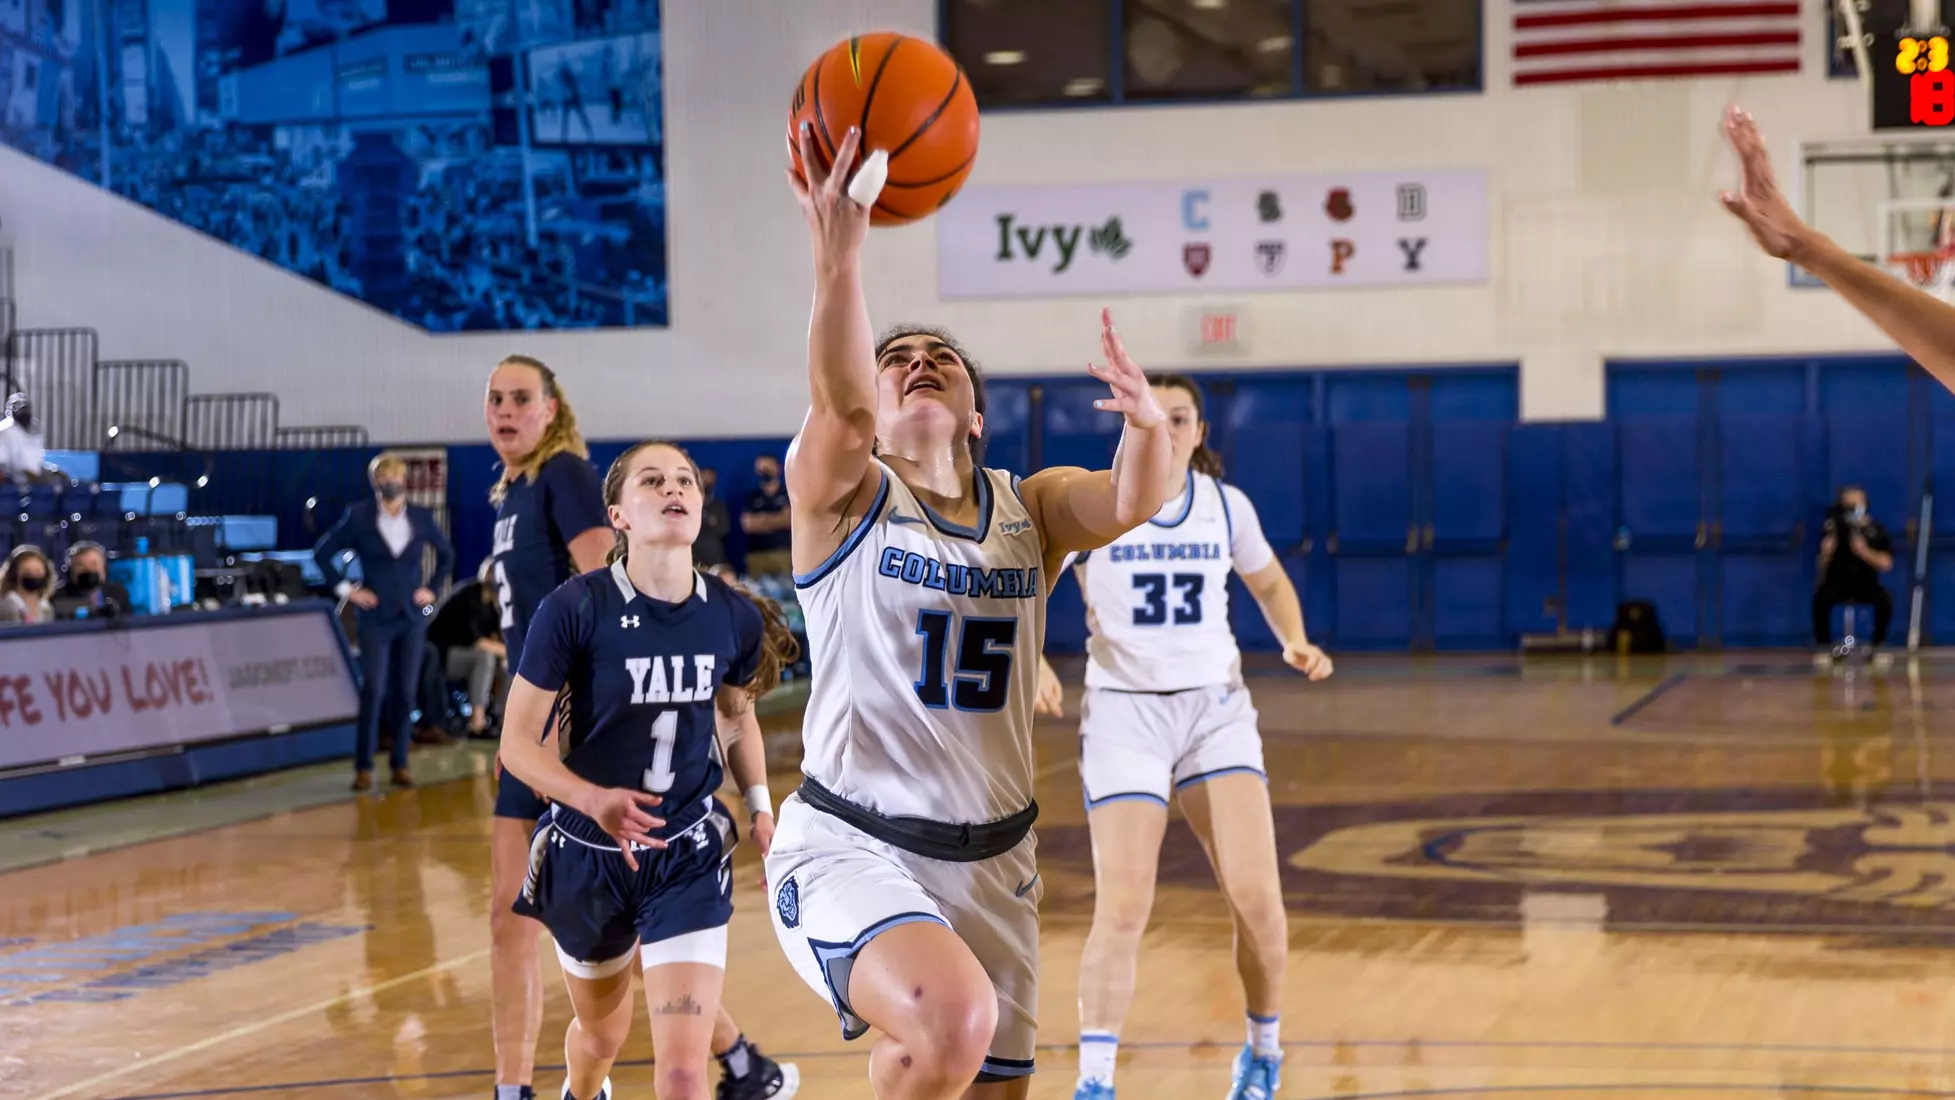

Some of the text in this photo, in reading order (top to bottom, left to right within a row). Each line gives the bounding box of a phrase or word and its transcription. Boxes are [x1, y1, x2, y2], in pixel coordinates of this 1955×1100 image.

[1181, 189, 1211, 231] C
[996, 213, 1083, 274] Ivy
[1329, 238, 1355, 274] P
[1396, 237, 1428, 272] Y
[878, 546, 1038, 598] COLUMBIA
[1110, 543, 1221, 562] COLUMBIA
[1132, 573, 1204, 625] 33
[625, 655, 715, 704] YALE
[914, 608, 1018, 713] 15
[44, 667, 113, 723] YOU
[120, 657, 215, 713] LOVE!
[642, 710, 678, 793] 1
